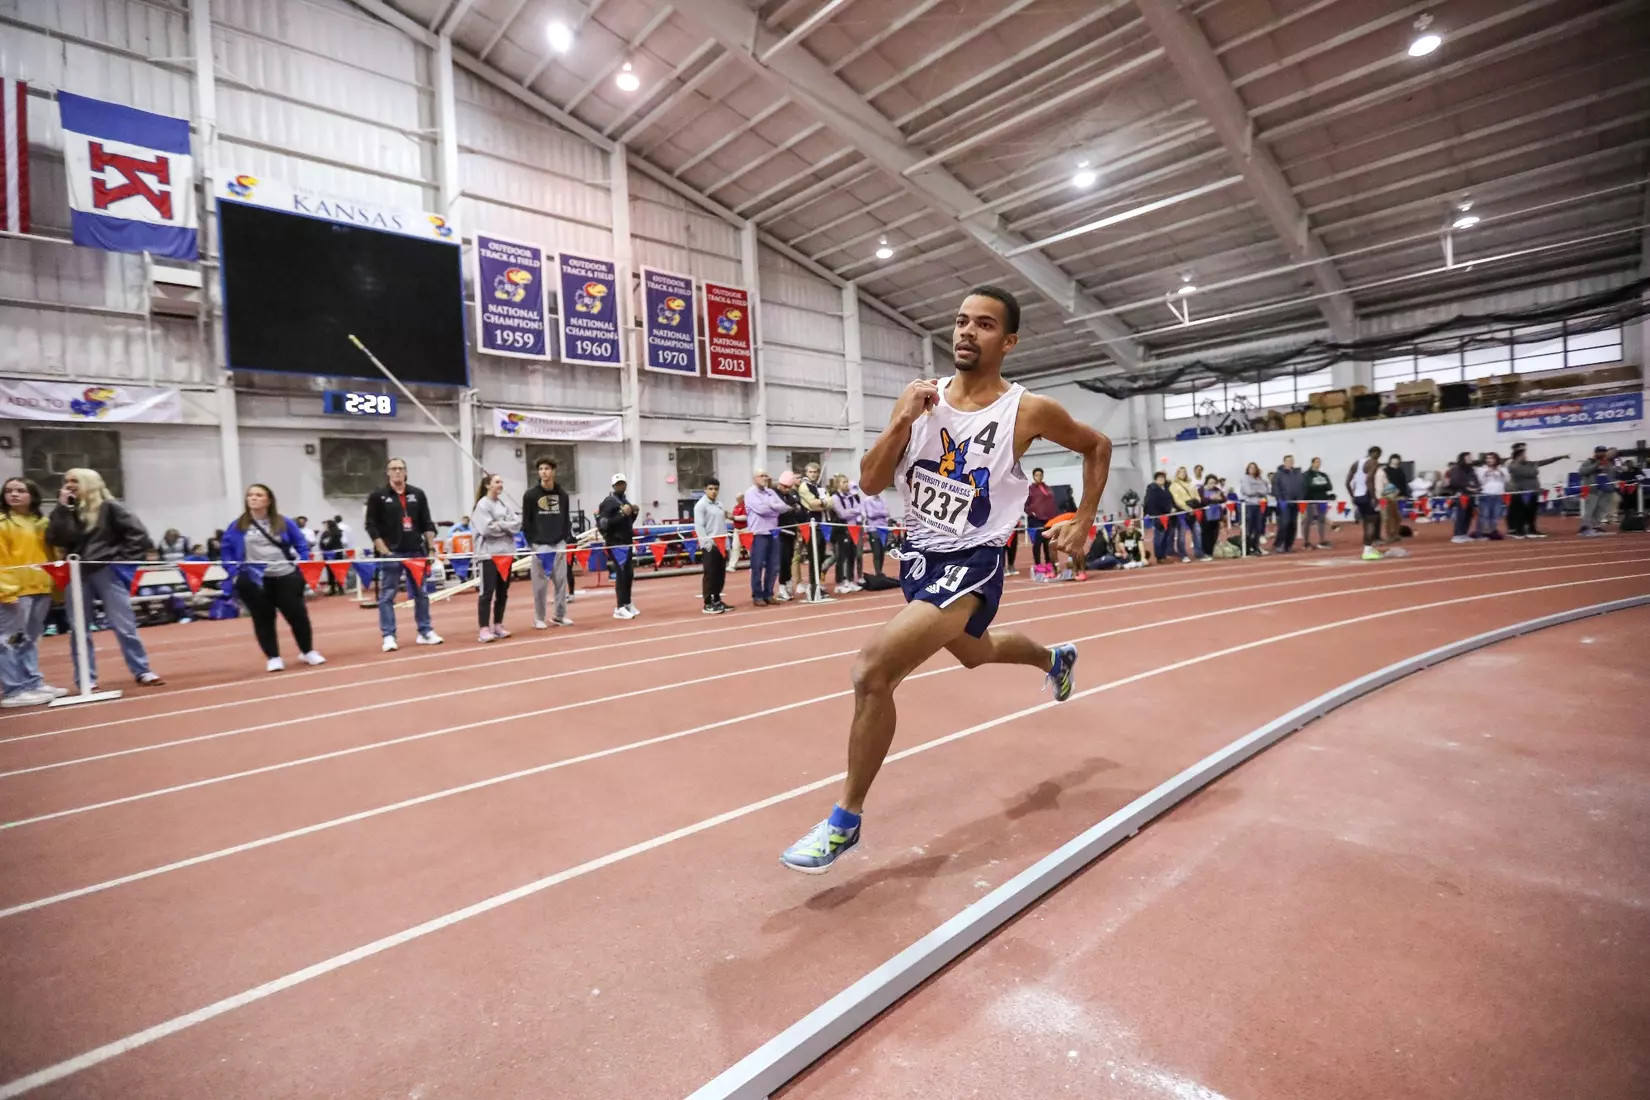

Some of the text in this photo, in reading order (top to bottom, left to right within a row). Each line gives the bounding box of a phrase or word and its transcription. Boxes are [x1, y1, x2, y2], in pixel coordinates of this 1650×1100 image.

[88, 141, 174, 220] K
[293, 194, 402, 229] KANSAS
[488, 241, 533, 258] OUTDOOR
[480, 248, 508, 262] TRACK
[517, 256, 541, 268] FIELD
[568, 258, 608, 272] OUTDOOR
[562, 265, 586, 277] TRACK
[594, 271, 616, 281] FIELD
[647, 281, 667, 291] TRACK
[674, 286, 692, 296] FIELD
[652, 275, 686, 288] OUTDOOR
[707, 293, 726, 303] TRACK
[731, 298, 748, 307] FIELD
[712, 287, 742, 299] OUTDOOR
[488, 304, 540, 320] NATIONAL
[570, 317, 614, 330] NATIONAL
[495, 329, 534, 348] 1959
[652, 328, 691, 341] NATIONAL
[713, 337, 747, 348] NATIONAL
[575, 340, 611, 357] 1960
[658, 350, 688, 366] 1970
[717, 357, 745, 372] 2013
[345, 393, 391, 414] 2:28
[1594, 408, 1636, 420] 2024
[973, 421, 999, 454] 4
[915, 471, 940, 487] UNIVERSITY
[941, 481, 949, 490] OF
[949, 483, 971, 498] KANSAS
[911, 481, 970, 525] 1237
[943, 565, 963, 587] 4
